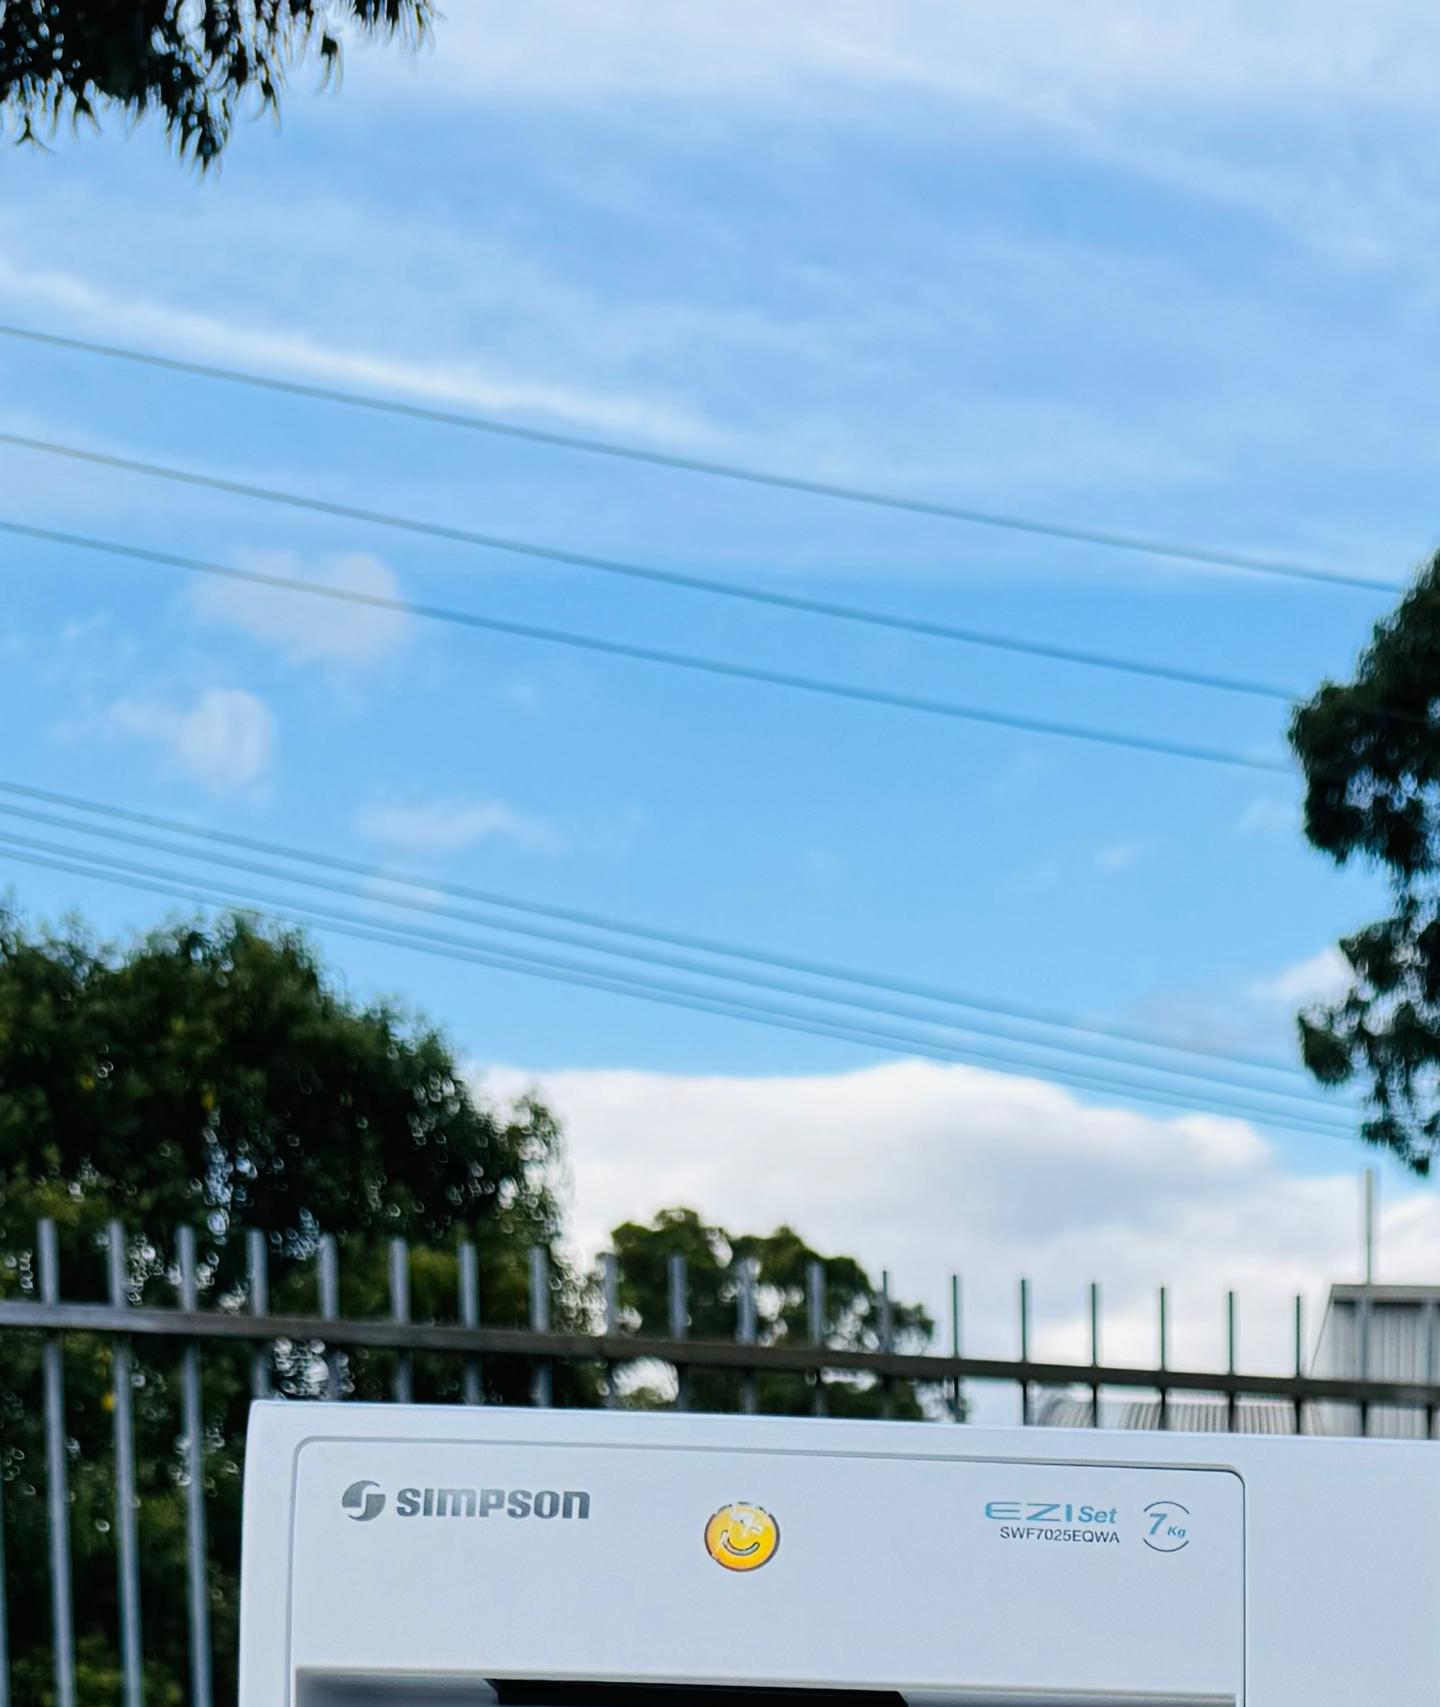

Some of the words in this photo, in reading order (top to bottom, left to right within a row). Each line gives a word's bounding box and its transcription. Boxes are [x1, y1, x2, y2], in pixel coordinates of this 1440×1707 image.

[984, 1501, 1073, 1522] EZI
[1078, 1506, 1118, 1524] Set
[1000, 1526, 1120, 1544] SWF7025EQWA
[1149, 1512, 1168, 1536] 7
[1167, 1525, 1187, 1539] Kg
